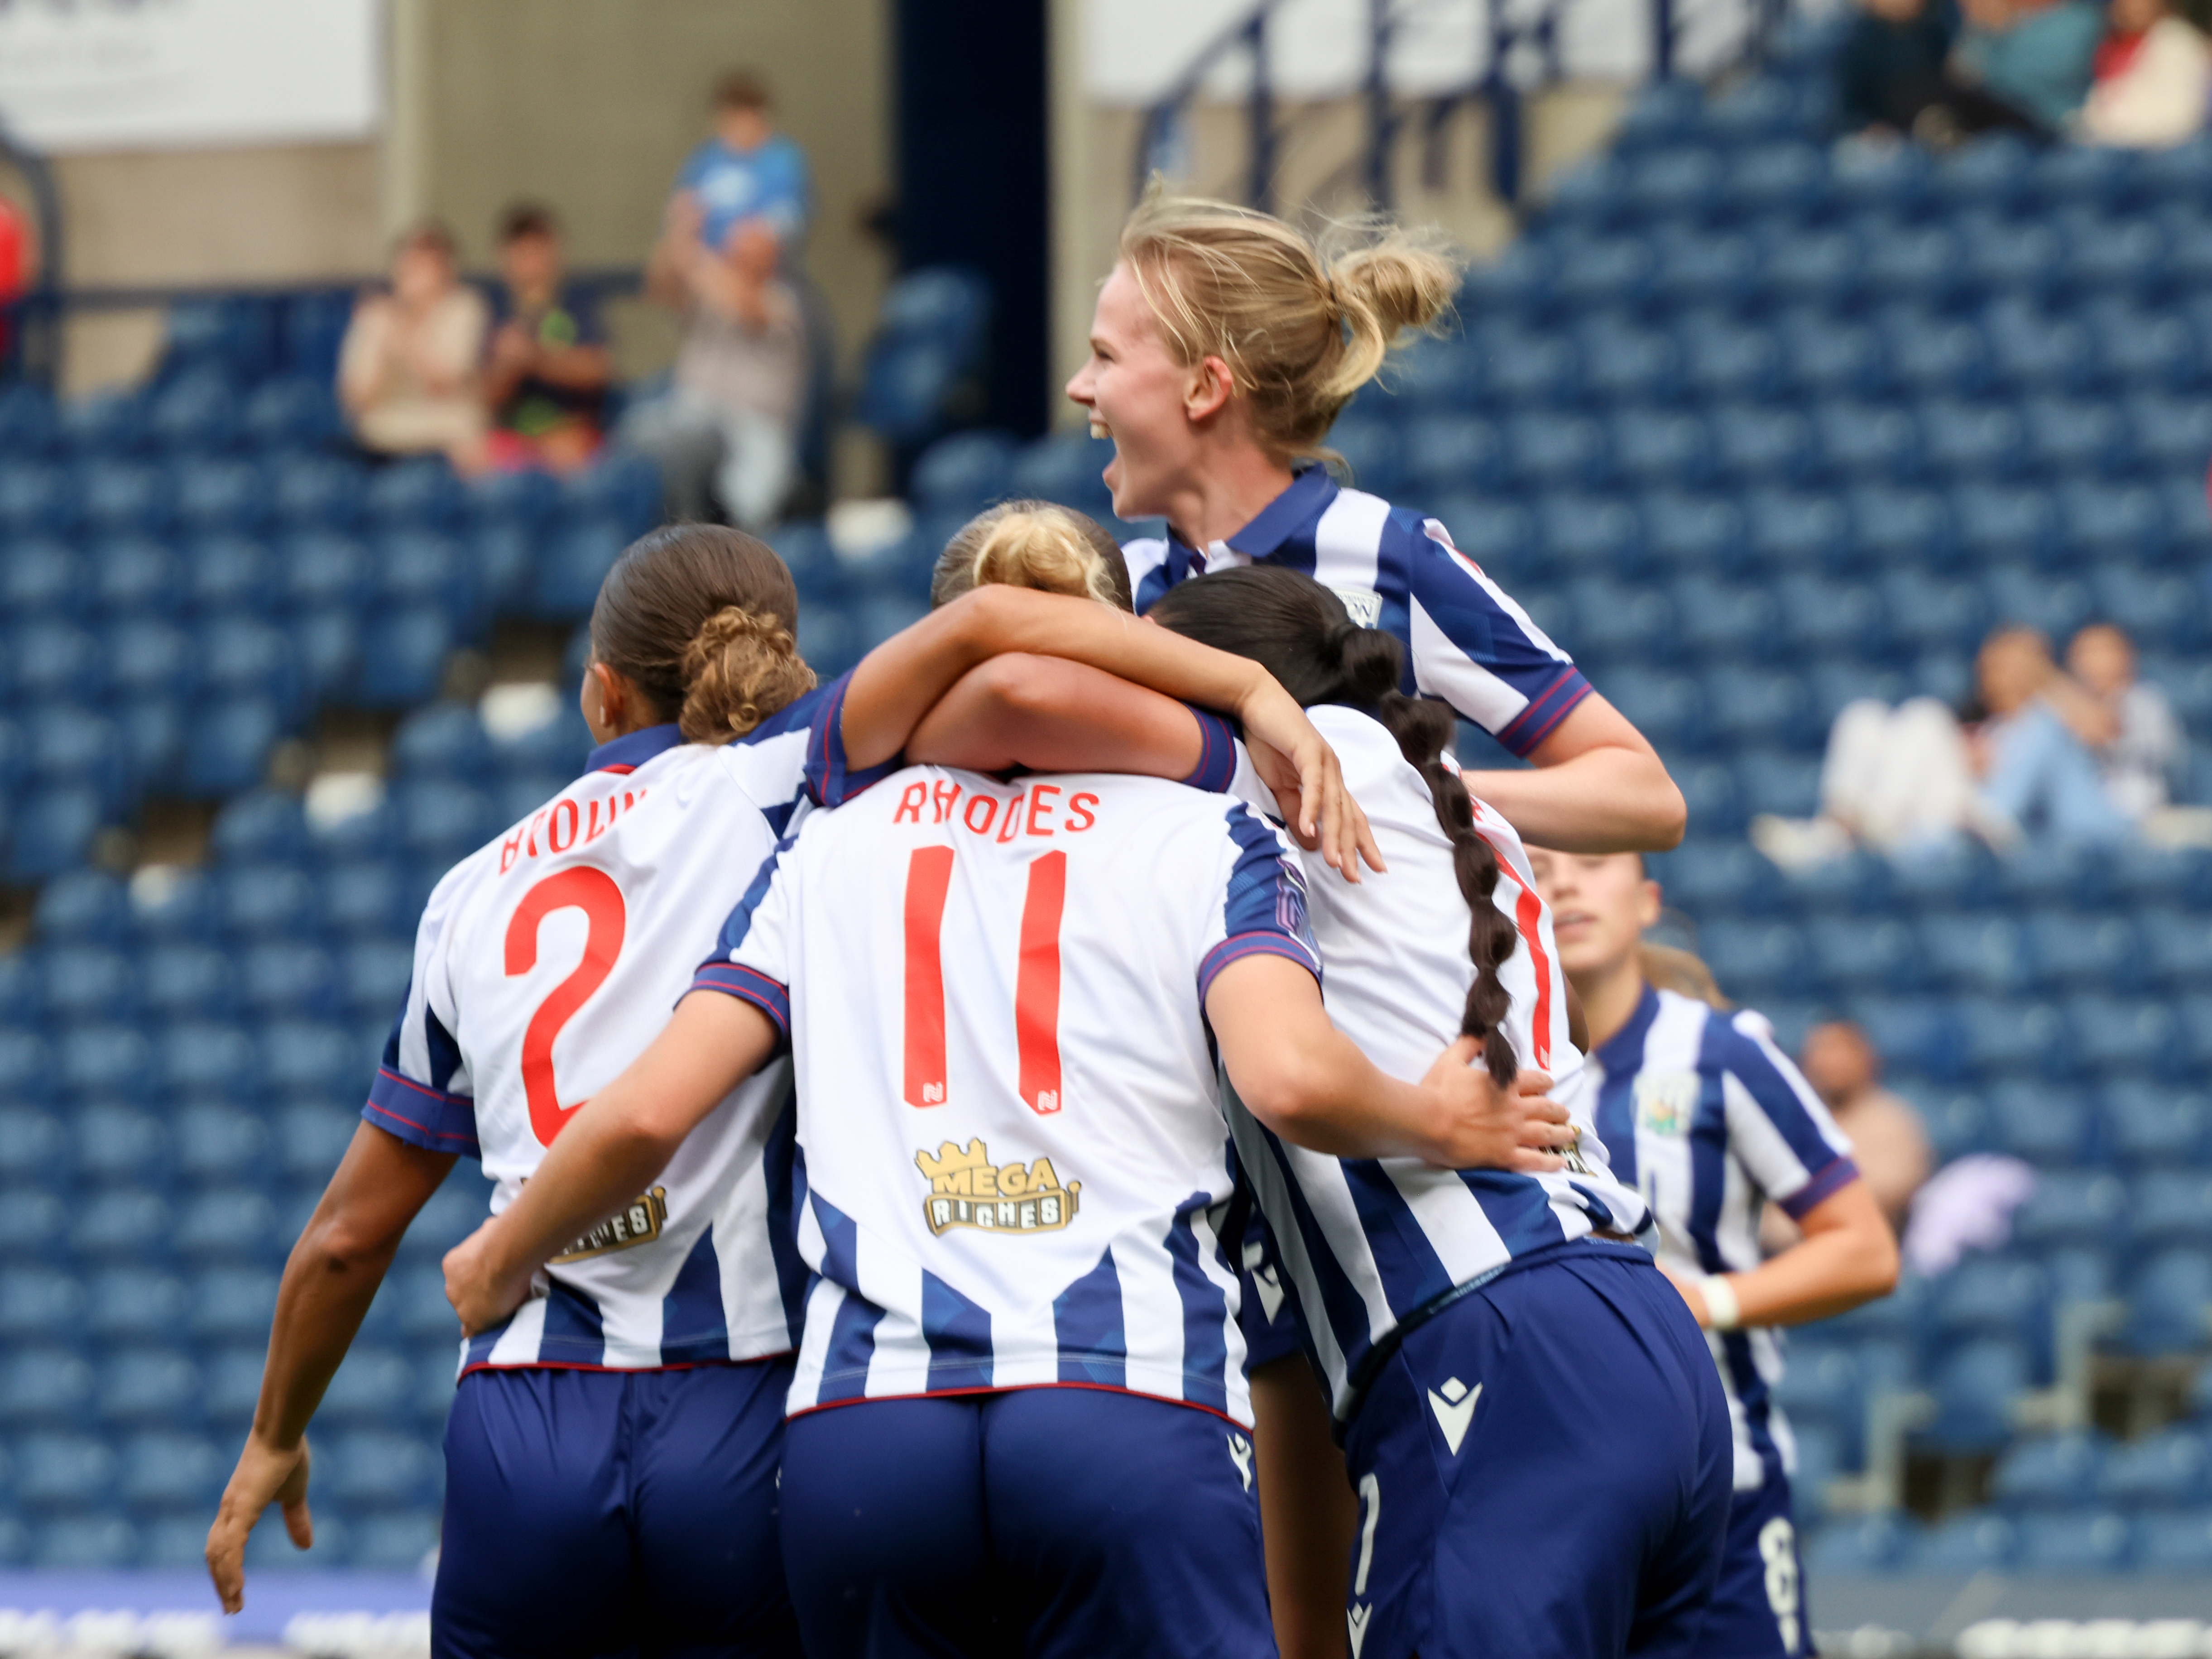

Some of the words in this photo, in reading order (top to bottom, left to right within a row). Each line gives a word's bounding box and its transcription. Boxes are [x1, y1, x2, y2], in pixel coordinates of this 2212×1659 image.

[499, 789, 647, 876] BROLI
[893, 780, 1099, 843] RHODES
[504, 866, 626, 1151] 2
[904, 845, 1067, 1116] 11
[931, 1196, 1059, 1229] RICHES
[932, 1157, 1060, 1195] MEGA
[1758, 1517, 1798, 1616] 8
